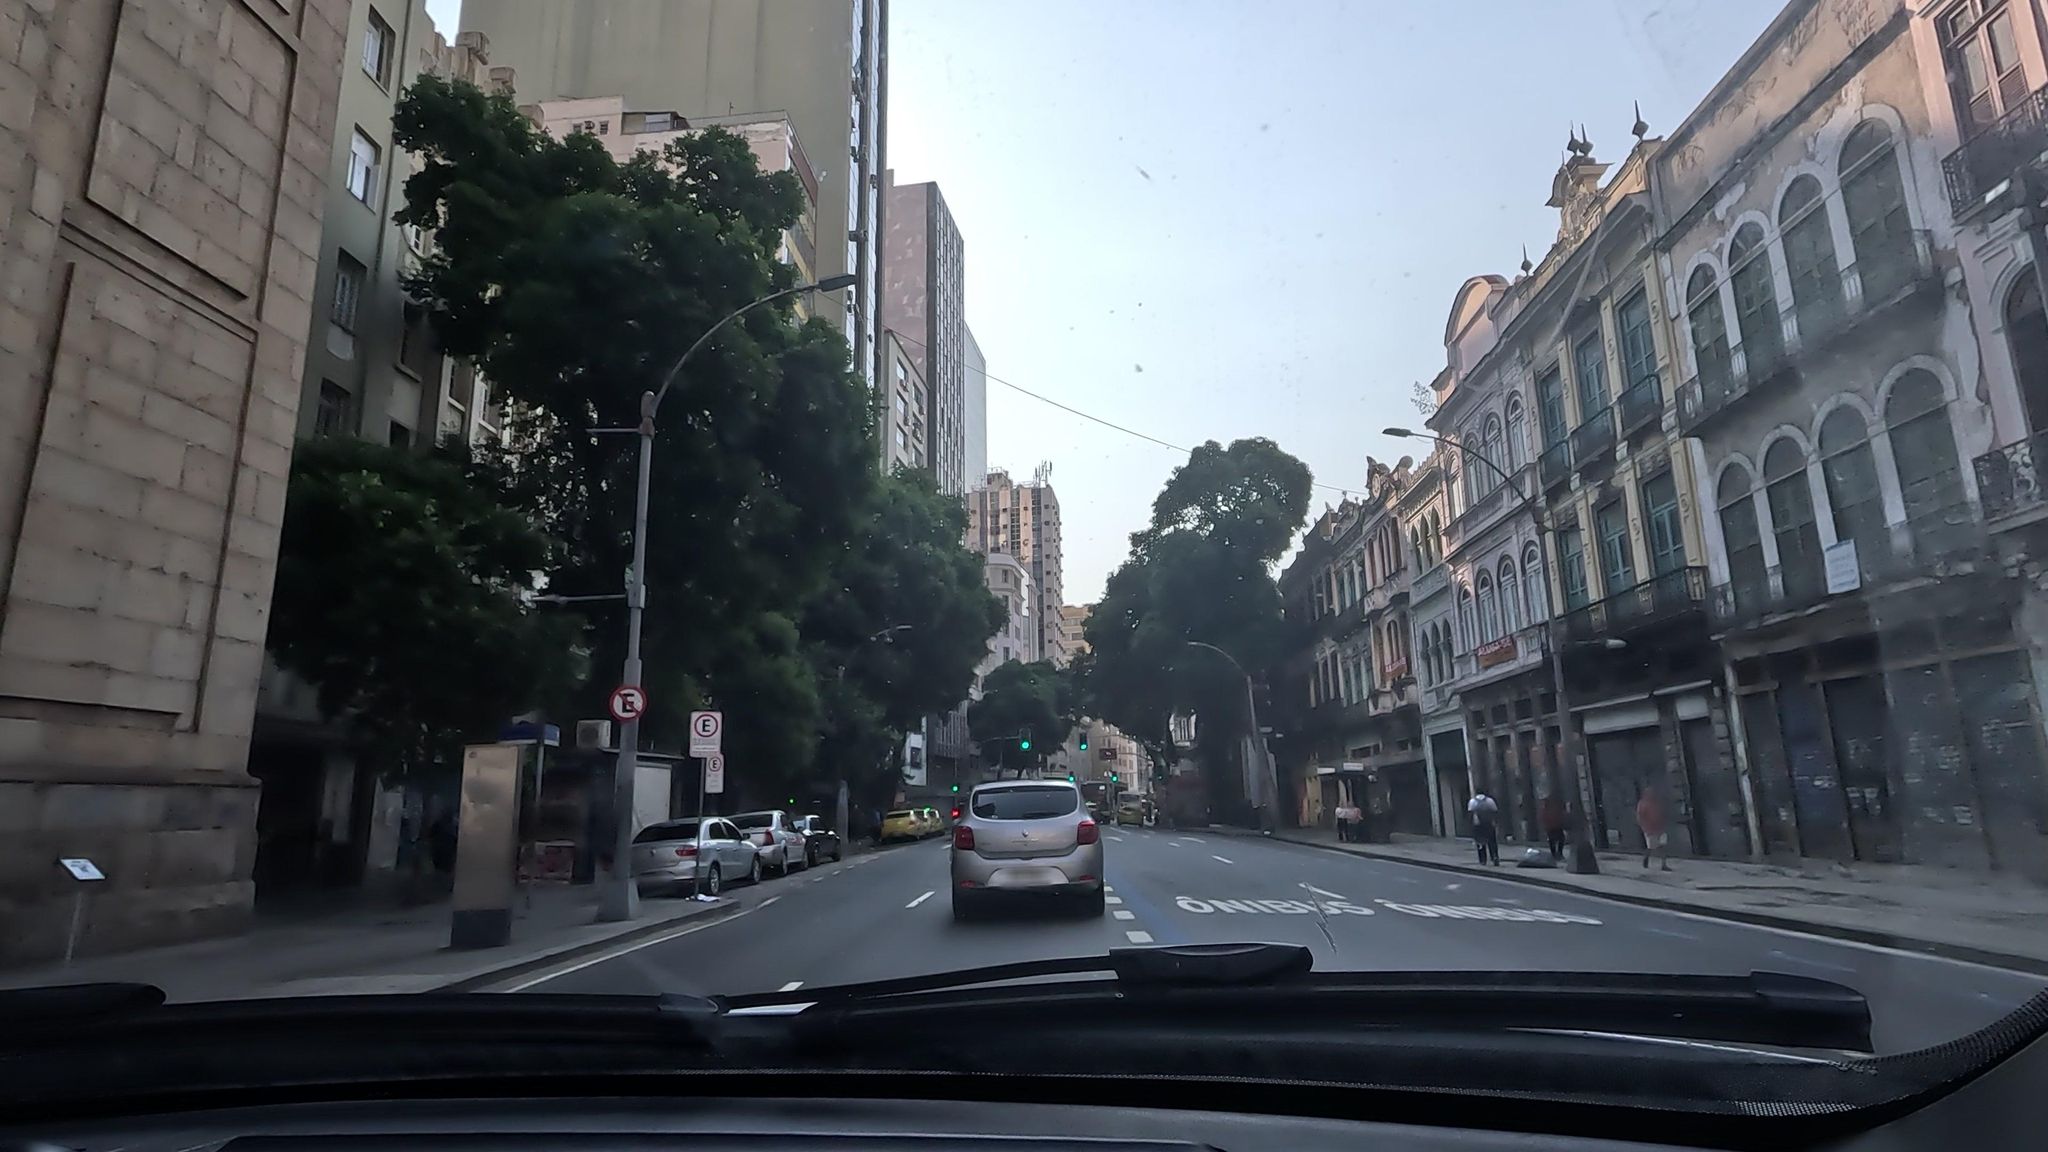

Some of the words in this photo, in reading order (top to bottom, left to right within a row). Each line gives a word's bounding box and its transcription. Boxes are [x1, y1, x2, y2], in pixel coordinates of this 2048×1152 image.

[622, 693, 634, 713] E
[702, 719, 711, 732] E
[1175, 896, 1376, 916] ÔNIBUS
